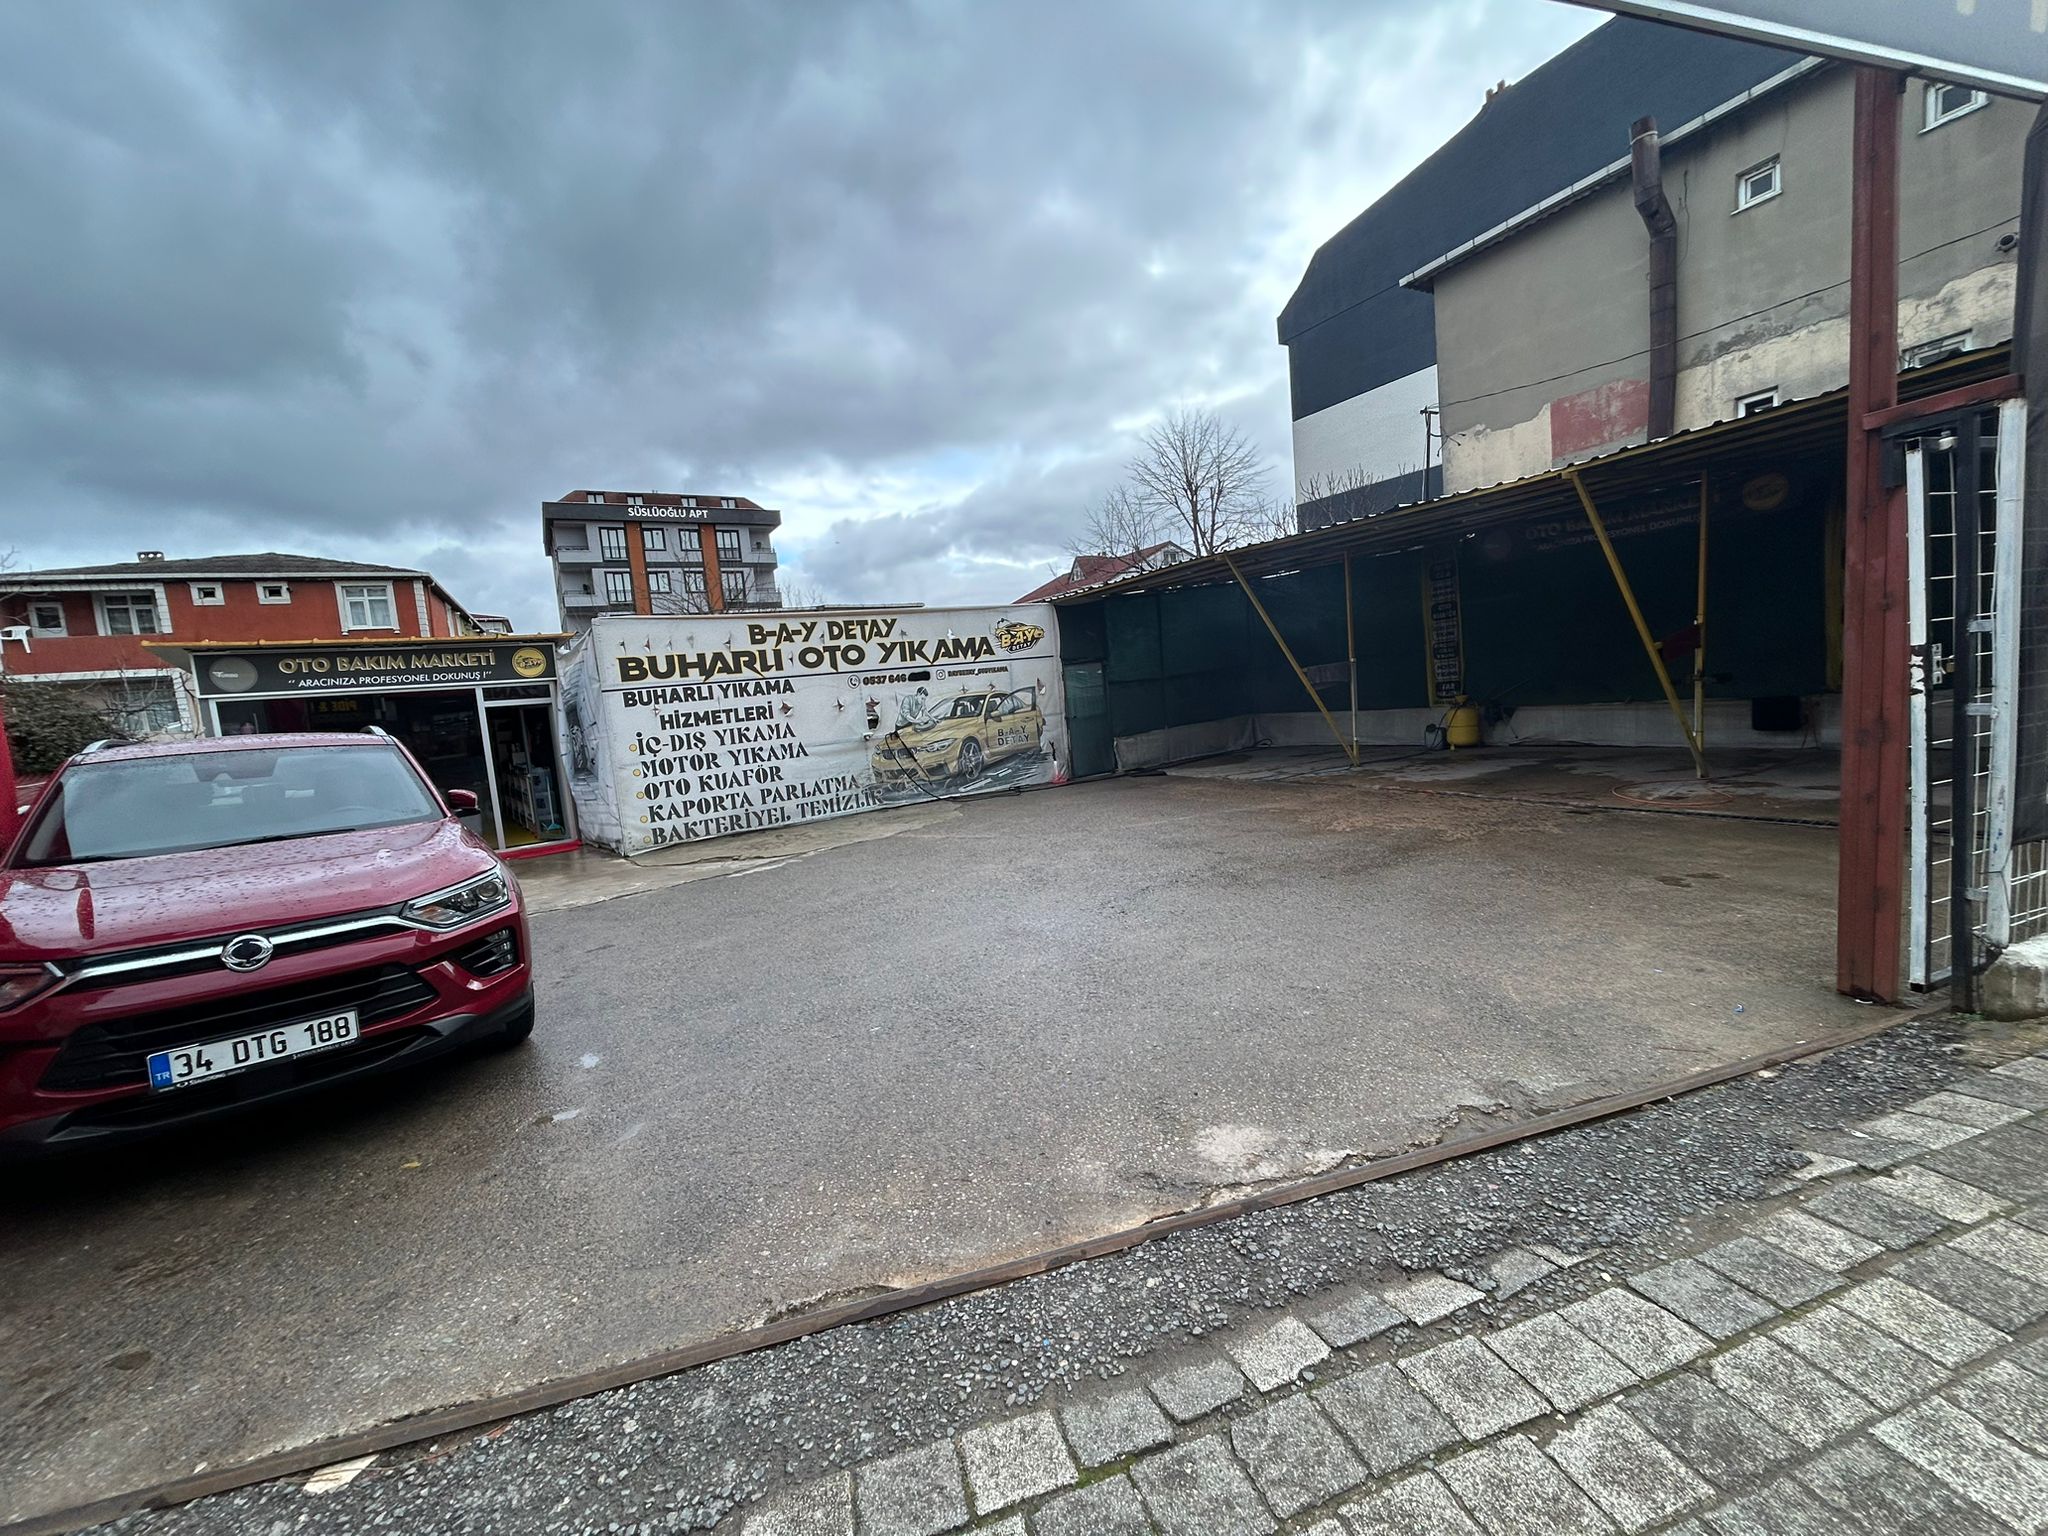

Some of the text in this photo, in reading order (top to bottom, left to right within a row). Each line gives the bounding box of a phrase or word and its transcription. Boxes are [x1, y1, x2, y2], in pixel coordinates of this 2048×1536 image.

[628, 506, 708, 519] SÜSLÜOĞLU APT
[747, 618, 897, 648] B-A-Y DETAY
[278, 649, 496, 674] OTO BAKIM MARKETİ
[616, 637, 995, 682] BUHARLI OTO YIKAMA
[298, 677, 357, 688] ARACINIZA
[358, 674, 431, 686] PROFESYONEL
[432, 671, 481, 683] DOKUNUŞ
[622, 679, 795, 708] BUHARLI YIKAMA
[863, 674, 907, 686] 0537 646
[659, 701, 774, 731] HİZMETLERİ
[635, 722, 796, 758] İÇ-DIŞ YIKAMA
[997, 734, 1030, 746] DETAY
[640, 742, 809, 779] MOTOR YIKAMA
[643, 765, 784, 801] OTO KUAFÖR
[648, 775, 859, 824] KAPORTA PARLATMA
[650, 788, 884, 845] BAKTERİYEL TEMİZLİK
[174, 1049, 214, 1078] 34
[232, 1031, 288, 1065] DTG
[304, 1016, 351, 1046] 188
[155, 1072, 170, 1081] TR
